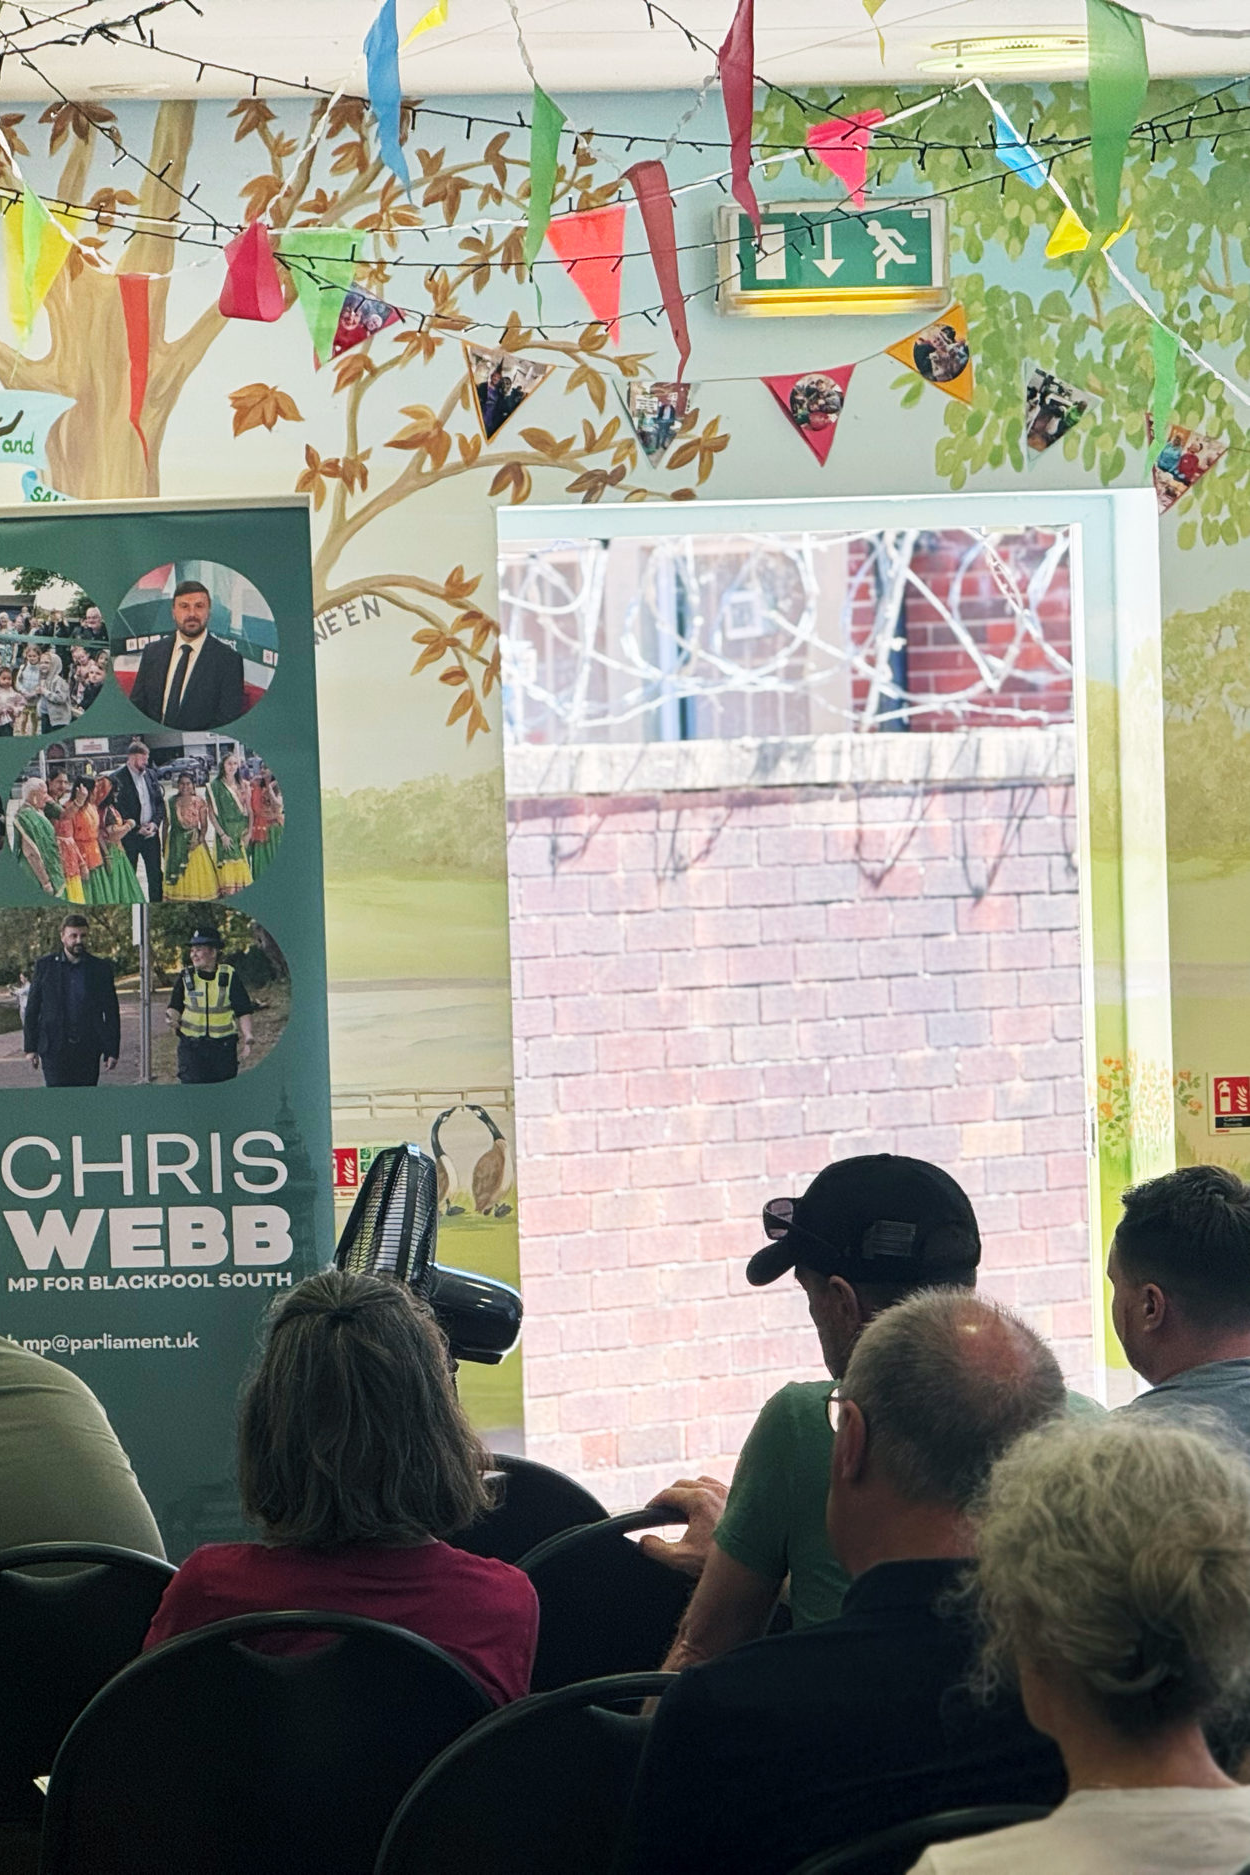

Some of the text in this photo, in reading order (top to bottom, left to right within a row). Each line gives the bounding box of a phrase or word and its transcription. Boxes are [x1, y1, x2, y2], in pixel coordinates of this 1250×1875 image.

[2, 431, 35, 455] and
[1, 1131, 288, 1199] CHRIS
[3, 1205, 294, 1270] WEBB
[8, 1272, 292, 1292] MP FOR BLACKPOOL SOUTH
